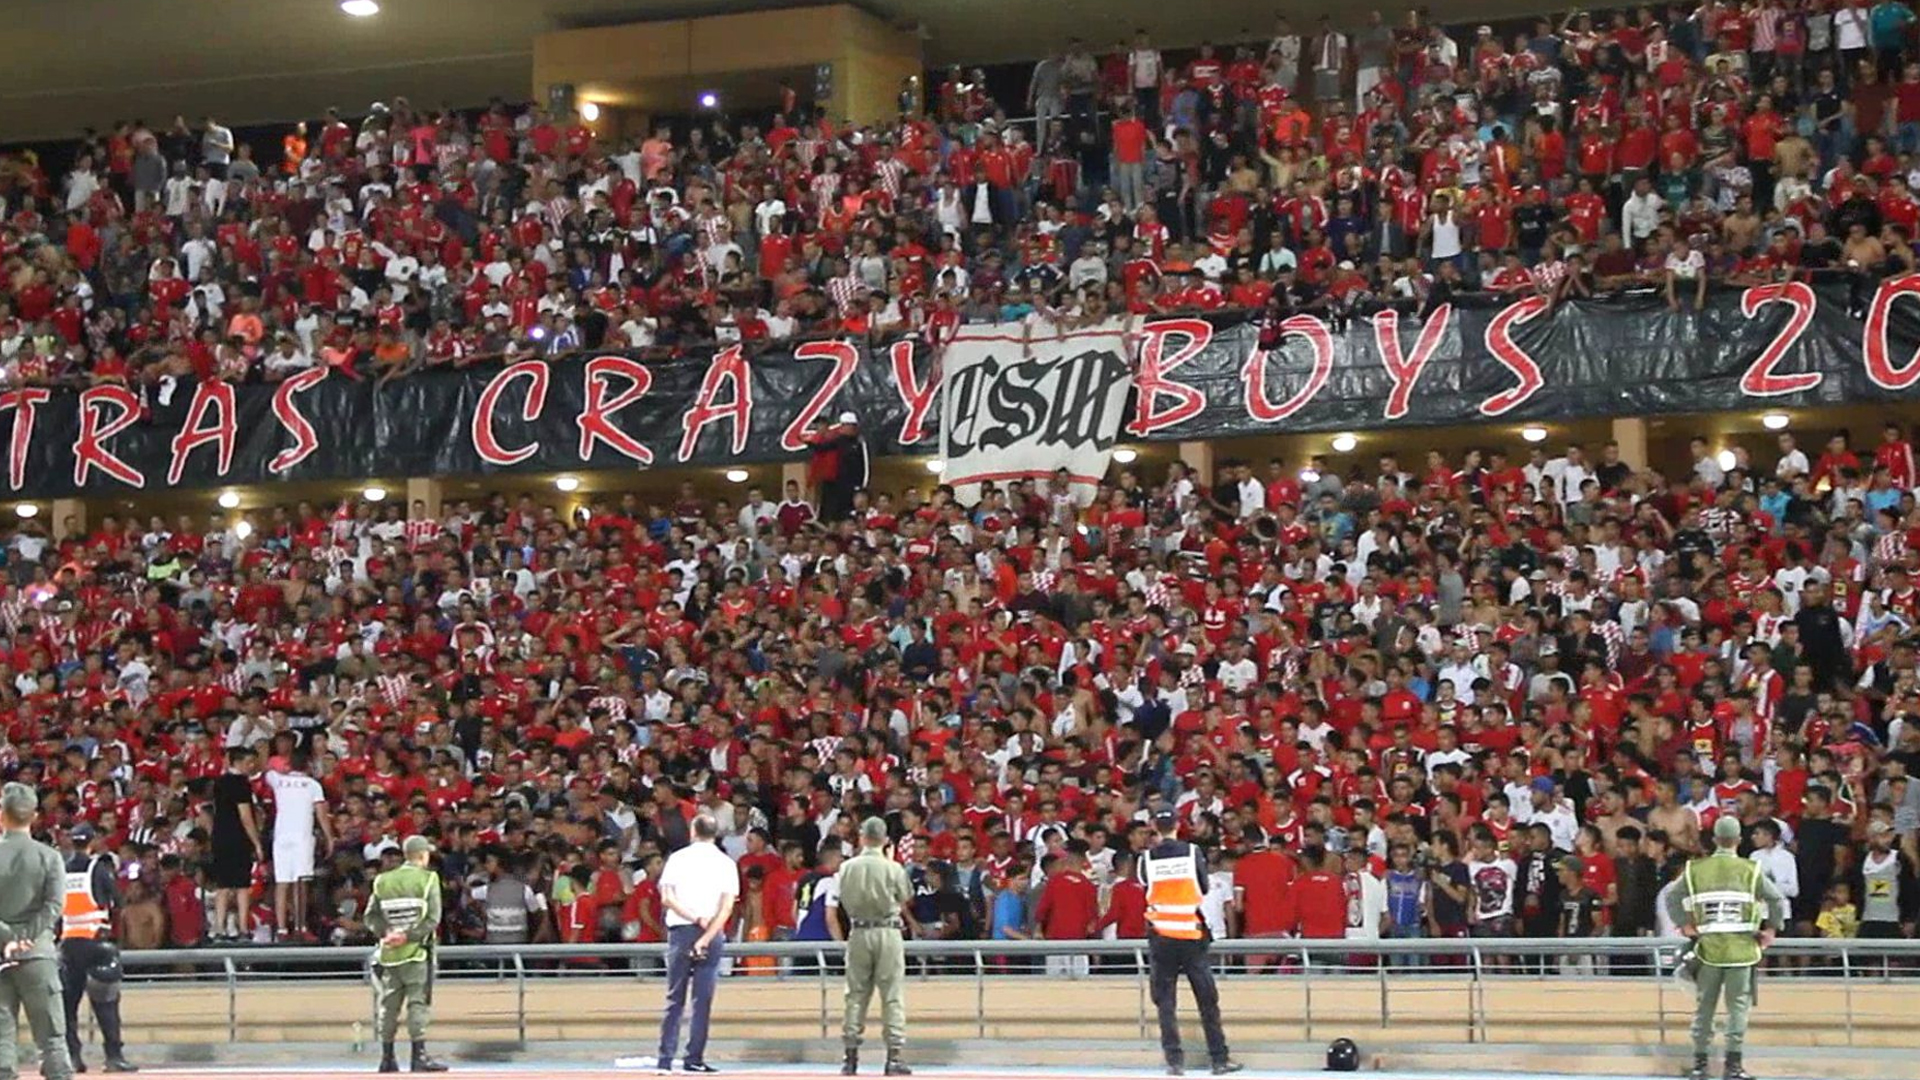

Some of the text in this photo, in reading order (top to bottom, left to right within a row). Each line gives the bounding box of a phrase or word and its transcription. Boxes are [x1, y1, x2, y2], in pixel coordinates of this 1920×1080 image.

[0, 366, 330, 491] TRAS
[473, 340, 943, 465] CRAZY
[1127, 294, 1550, 437] BOYS
